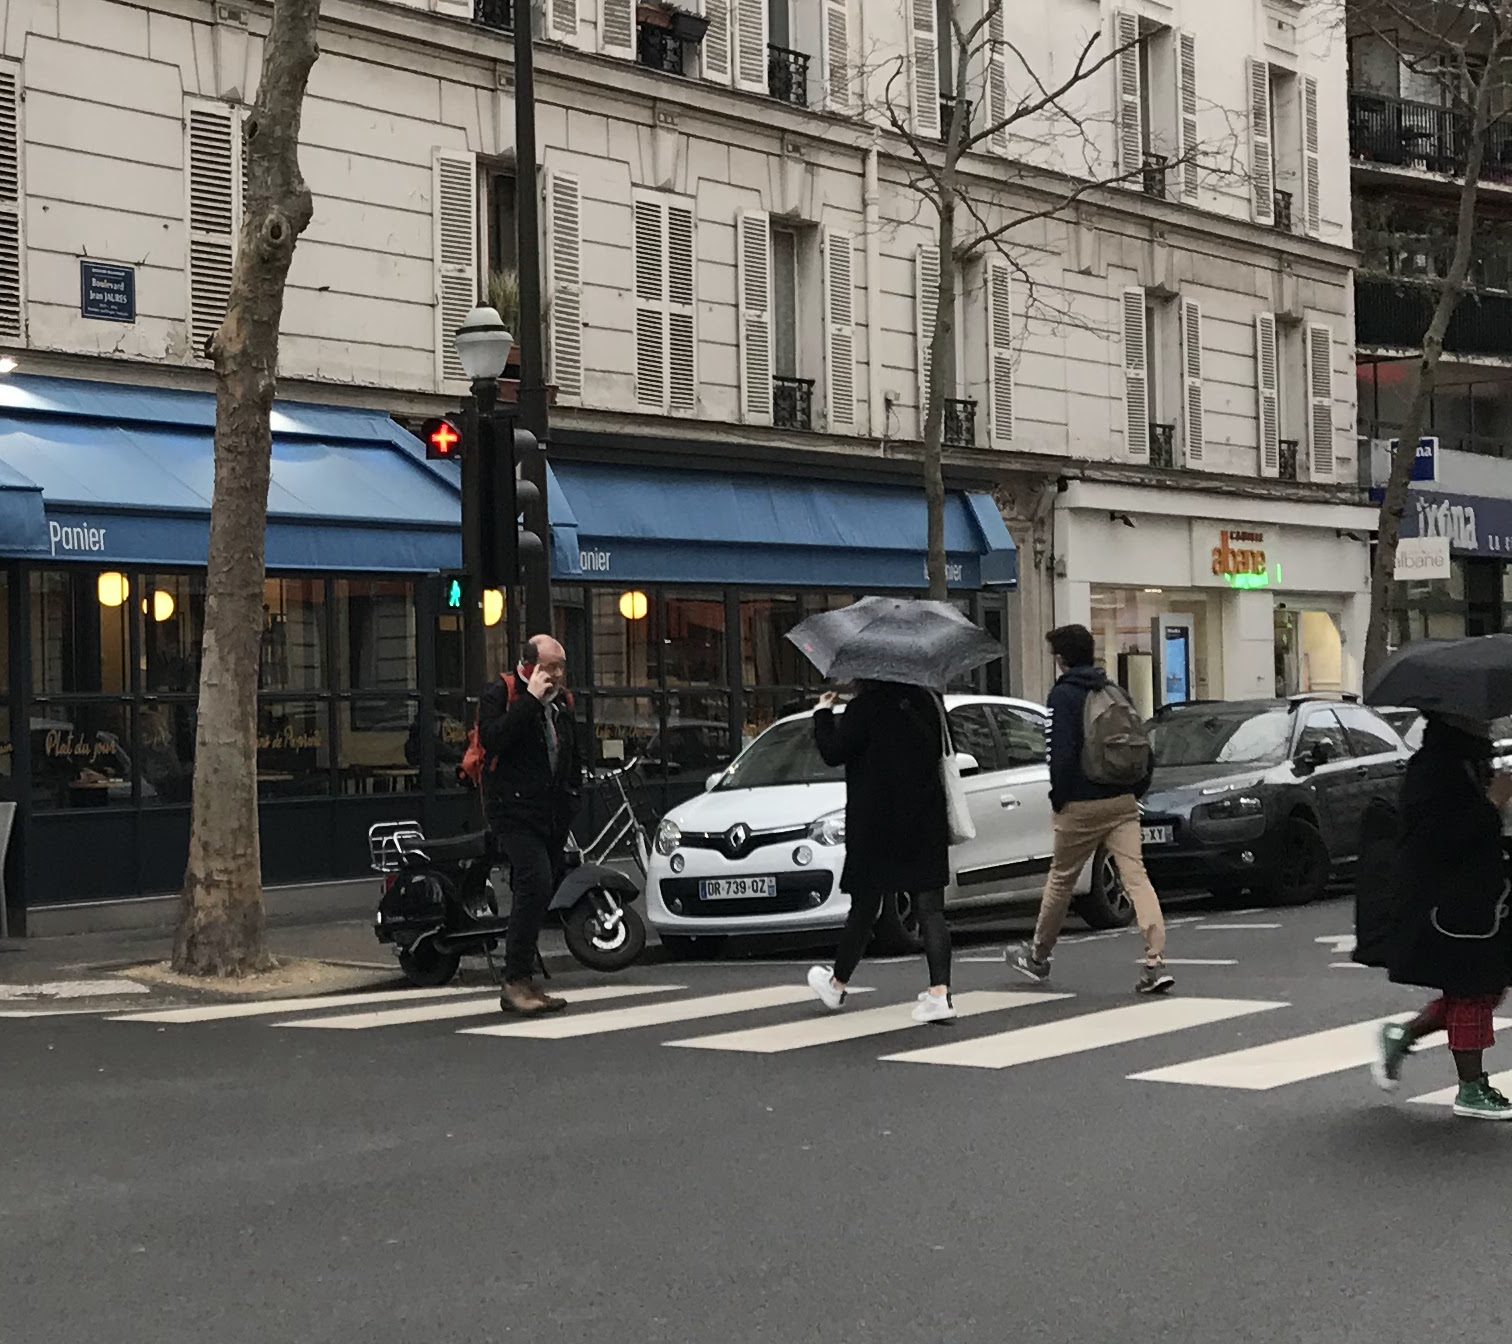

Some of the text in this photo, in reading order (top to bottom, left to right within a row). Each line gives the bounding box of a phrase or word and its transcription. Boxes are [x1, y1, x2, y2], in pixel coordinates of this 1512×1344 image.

[49, 520, 106, 556] Panier
[1212, 530, 1266, 575] albane
[579, 547, 611, 571] anier
[46, 729, 116, 763] Plat du jour
